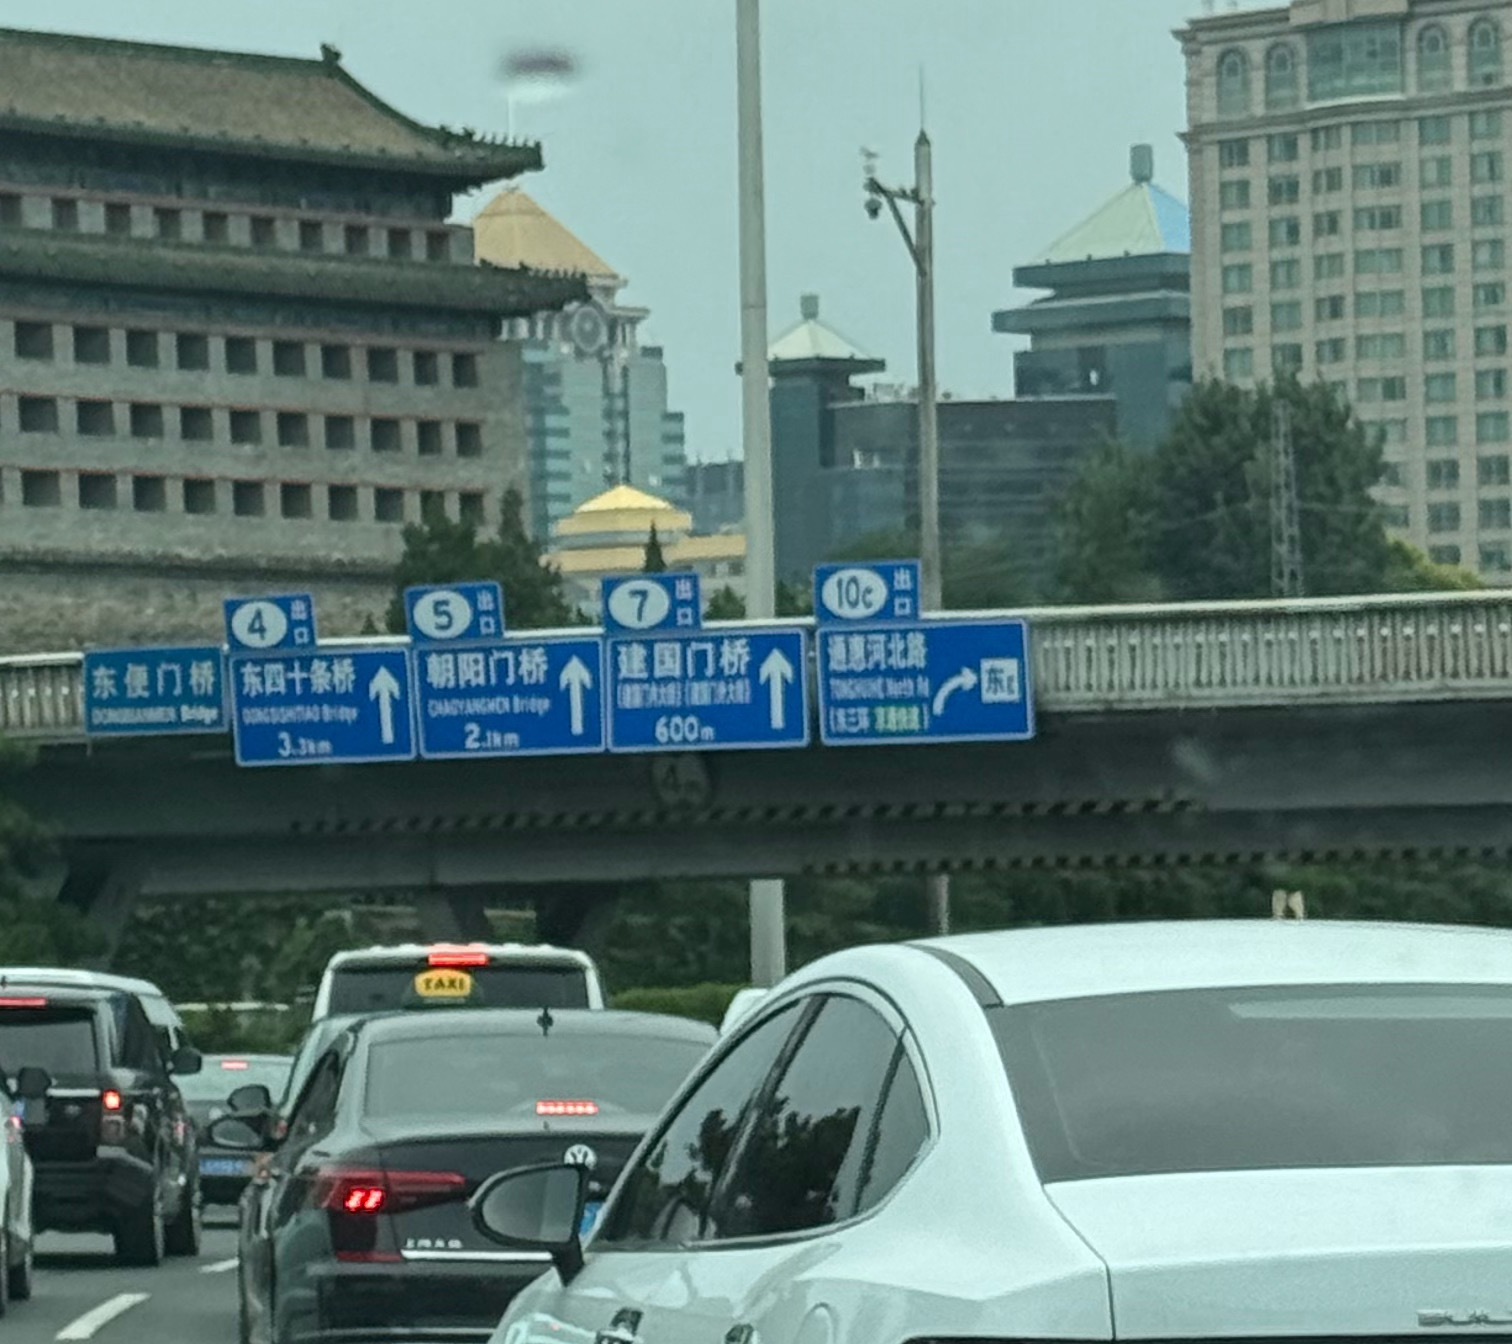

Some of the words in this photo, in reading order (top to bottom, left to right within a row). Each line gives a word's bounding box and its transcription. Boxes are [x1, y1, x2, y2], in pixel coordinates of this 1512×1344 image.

[629, 589, 650, 621] 7
[675, 580, 693, 626] 出口
[893, 567, 912, 616] 出口
[246, 608, 267, 640] 4
[290, 601, 308, 645] 出口
[432, 599, 454, 631] 5
[476, 591, 495, 635] 出口
[240, 657, 357, 698] 东四十条桥
[426, 646, 548, 689] 朝阳门桥
[616, 637, 751, 679] 建国门桥
[91, 660, 216, 699] 东便门桥
[512, 694, 551, 717] Bridge
[278, 731, 334, 757] 3.3km
[654, 715, 716, 744] 600m
[423, 977, 465, 992] TAXI
